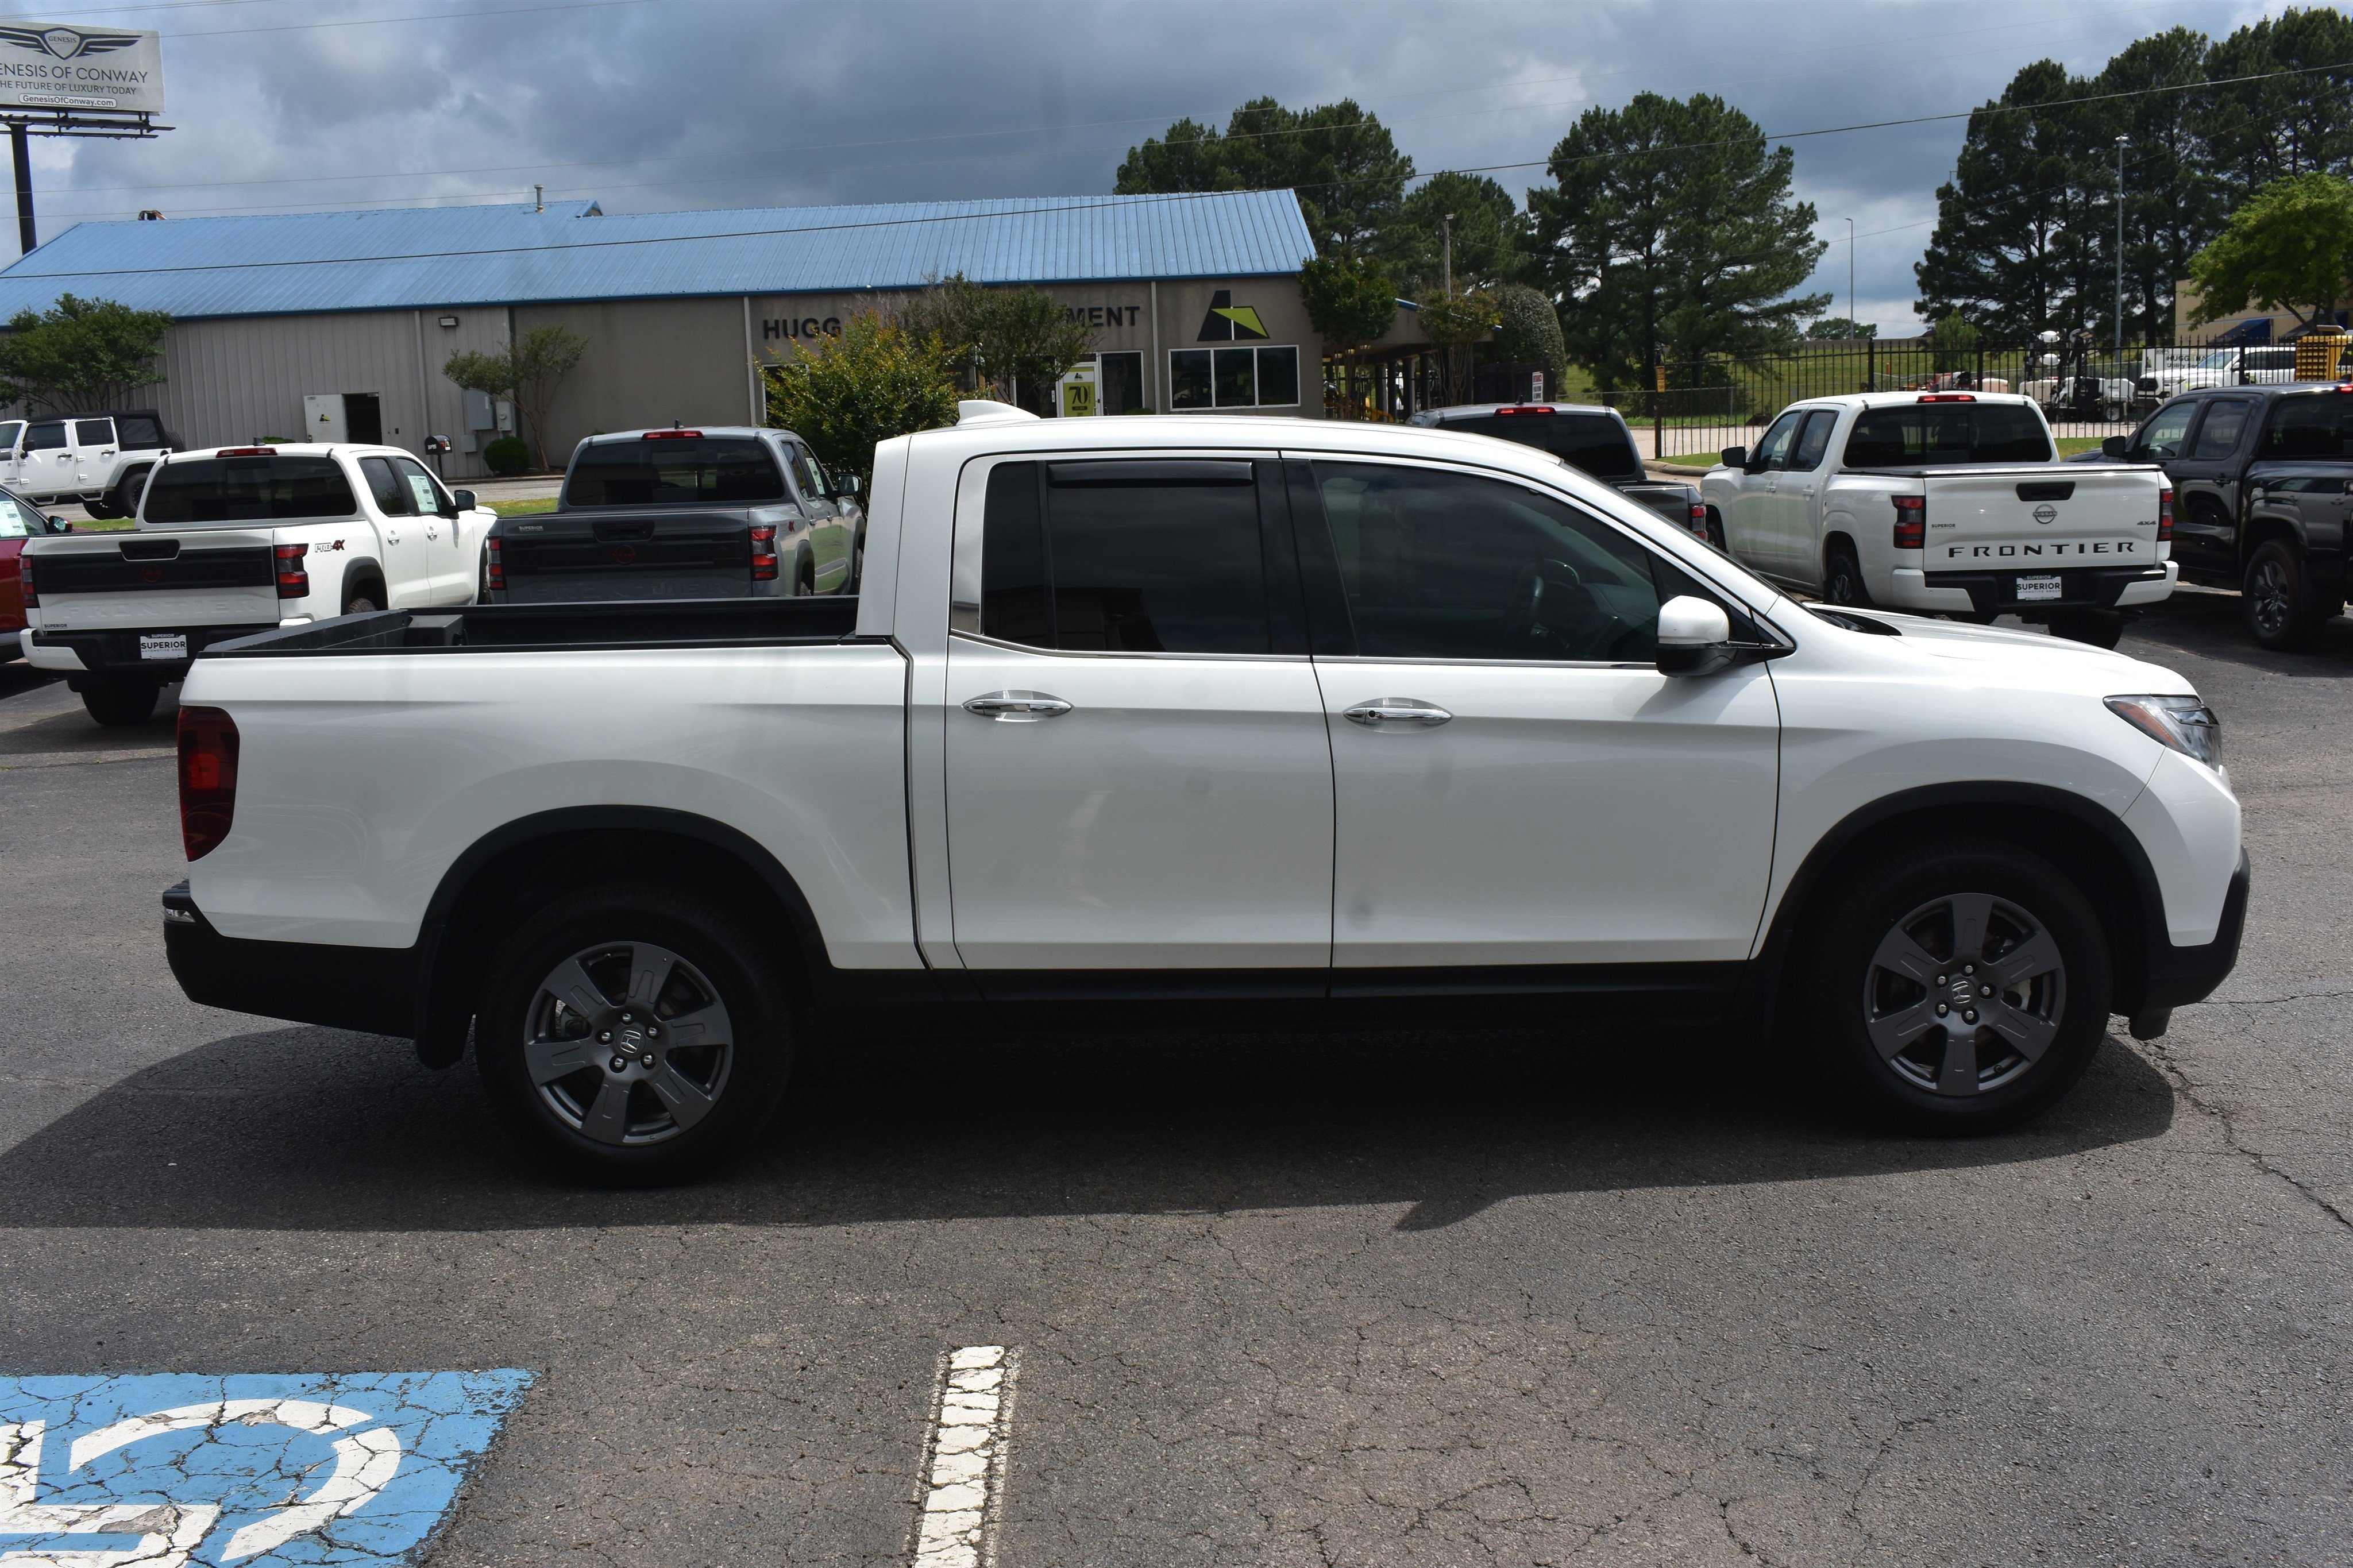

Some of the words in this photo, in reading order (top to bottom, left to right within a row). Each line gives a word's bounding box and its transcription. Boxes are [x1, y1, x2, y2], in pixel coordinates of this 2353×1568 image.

[0, 63, 47, 78] ENESIS
[52, 66, 72, 79] OF
[76, 67, 148, 83] CONWAY
[0, 80, 13, 88] HE
[16, 81, 52, 90] FUTURE
[69, 84, 105, 93] LUXURY
[107, 86, 136, 95] TODAY
[23, 95, 114, 107] GenesisOfConway.com
[763, 318, 841, 339] HUGG
[1069, 386, 1088, 404] 70
[1948, 542, 2134, 558] FRONTIER
[2017, 582, 2061, 590] SUPERIOR
[141, 641, 186, 649] SUPERIOR
